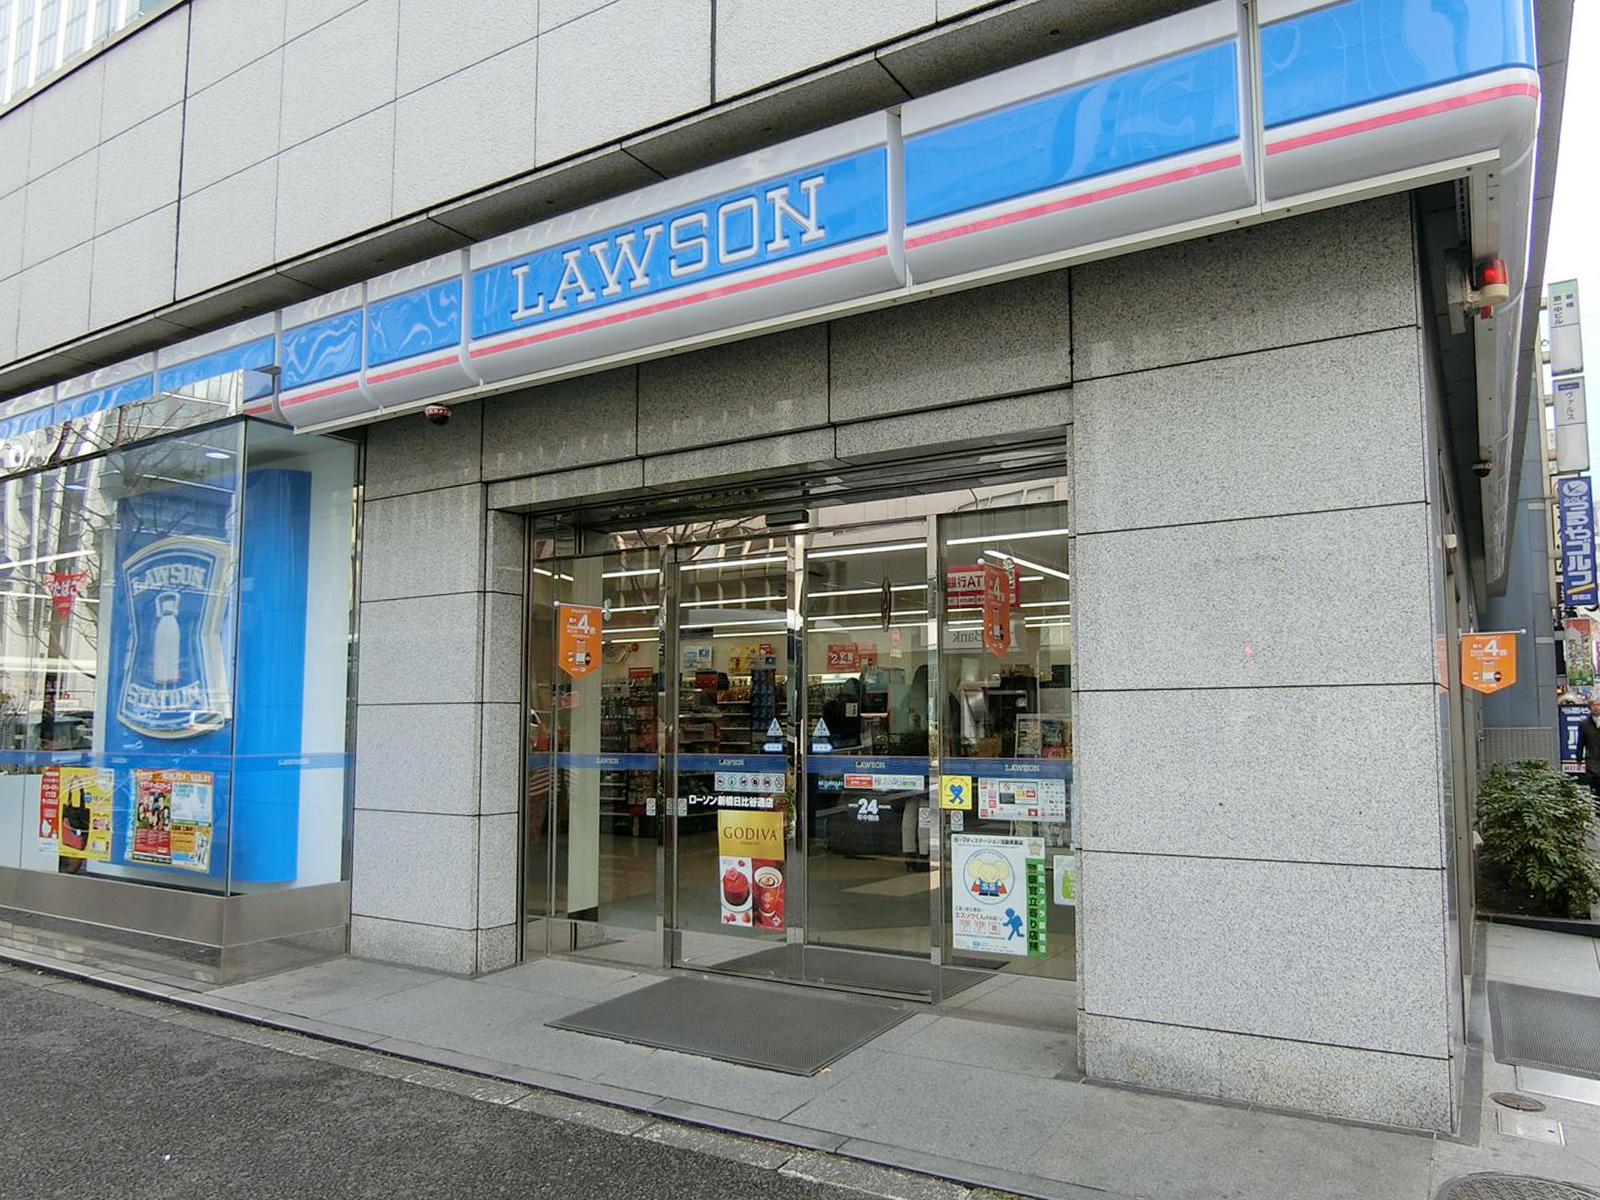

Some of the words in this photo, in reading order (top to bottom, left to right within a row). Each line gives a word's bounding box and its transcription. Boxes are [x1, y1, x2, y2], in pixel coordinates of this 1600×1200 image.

[511, 173, 825, 321] LAWSON
[1563, 501, 1593, 586] つるやゴルフ
[1005, 764, 1040, 772] LAWSON
[857, 798, 878, 814] 24
[723, 826, 778, 841] GODIVA
